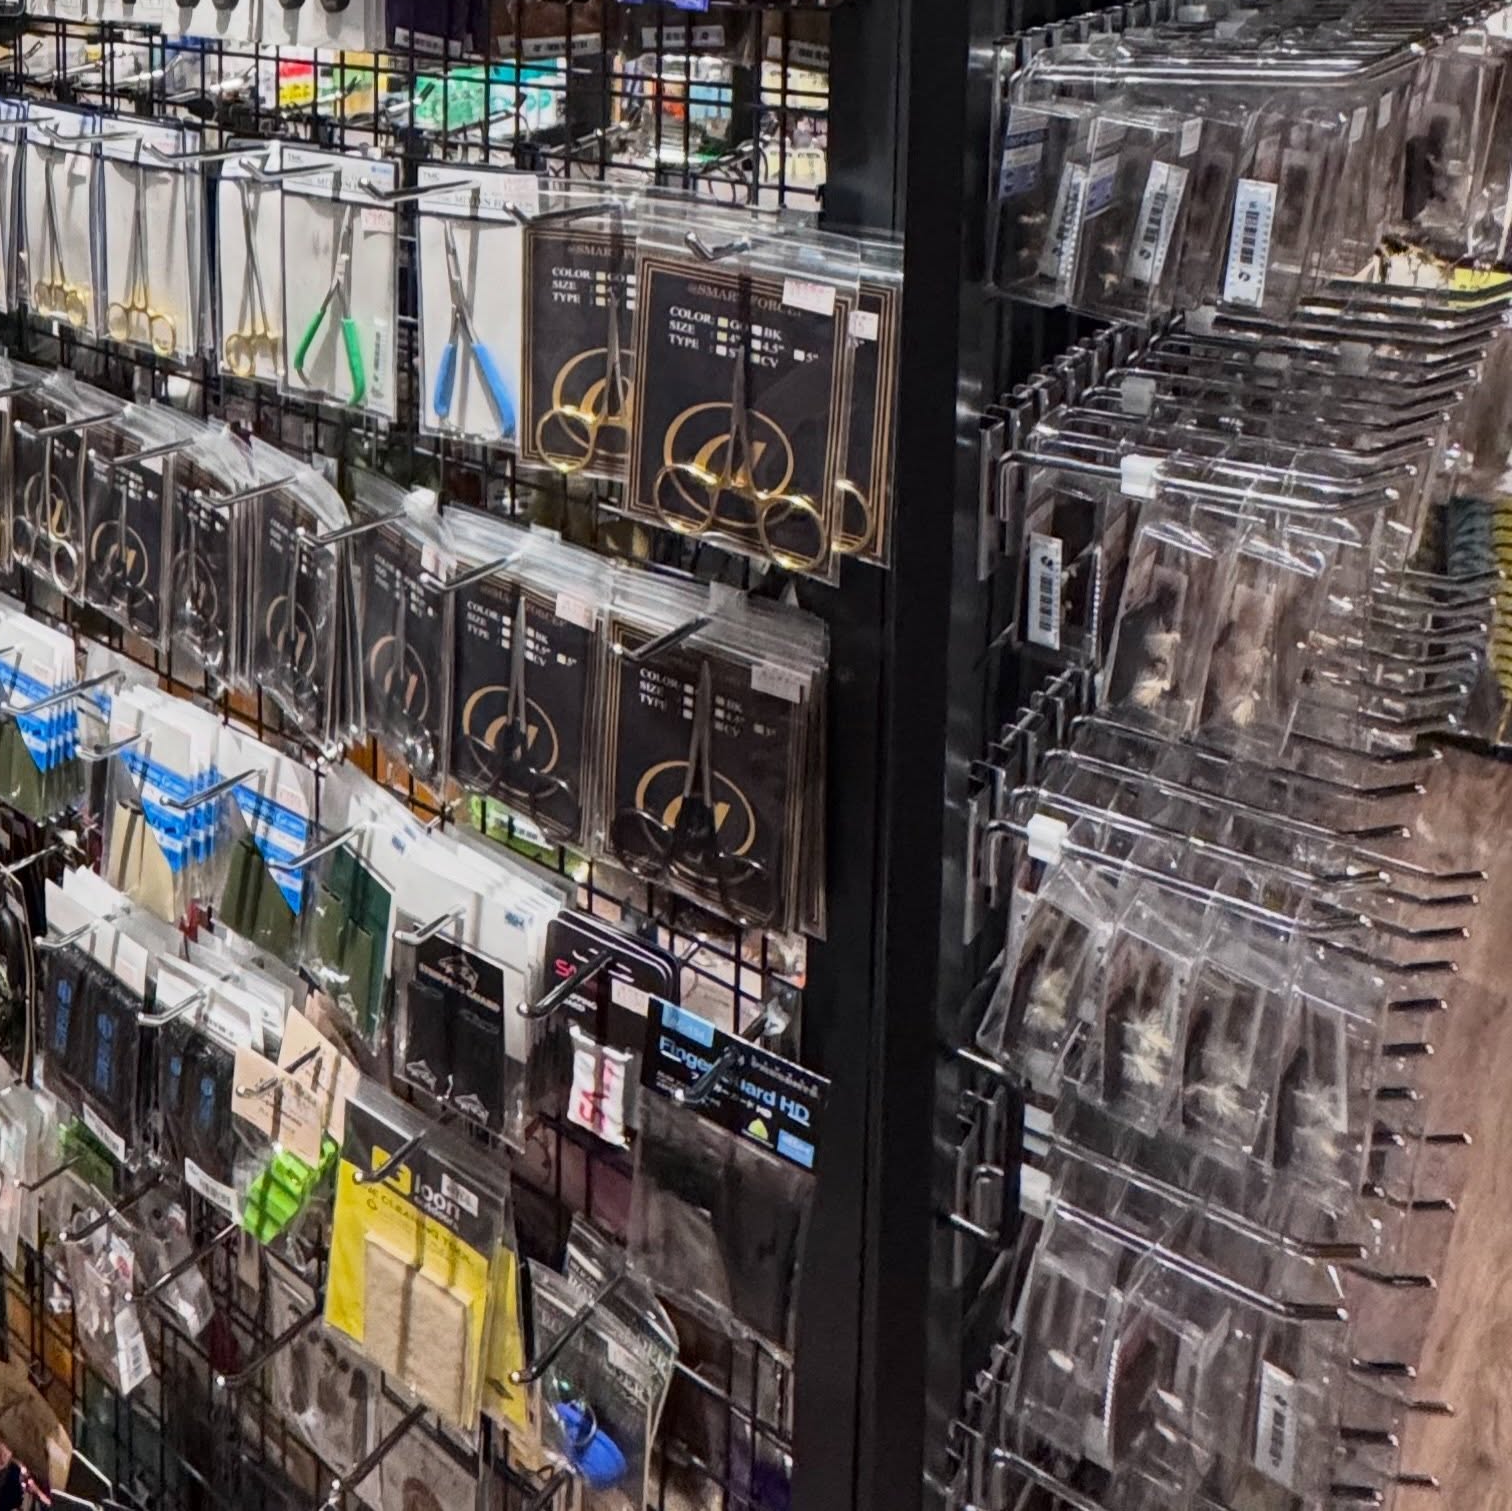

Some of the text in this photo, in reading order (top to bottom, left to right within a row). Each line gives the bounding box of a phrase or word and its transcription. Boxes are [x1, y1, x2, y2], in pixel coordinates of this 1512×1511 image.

[552, 279, 577, 291] SIZE
[552, 292, 582, 304] TYPE
[669, 319, 696, 335] SIZE
[761, 327, 783, 341] BK
[669, 333, 700, 350] TYPE
[760, 353, 779, 369] CV
[466, 610, 488, 627] SIZE
[466, 623, 491, 641] TYPE
[740, 1077, 776, 1108] ard
[779, 1096, 810, 1123] HD
[414, 1173, 461, 1221] loon
